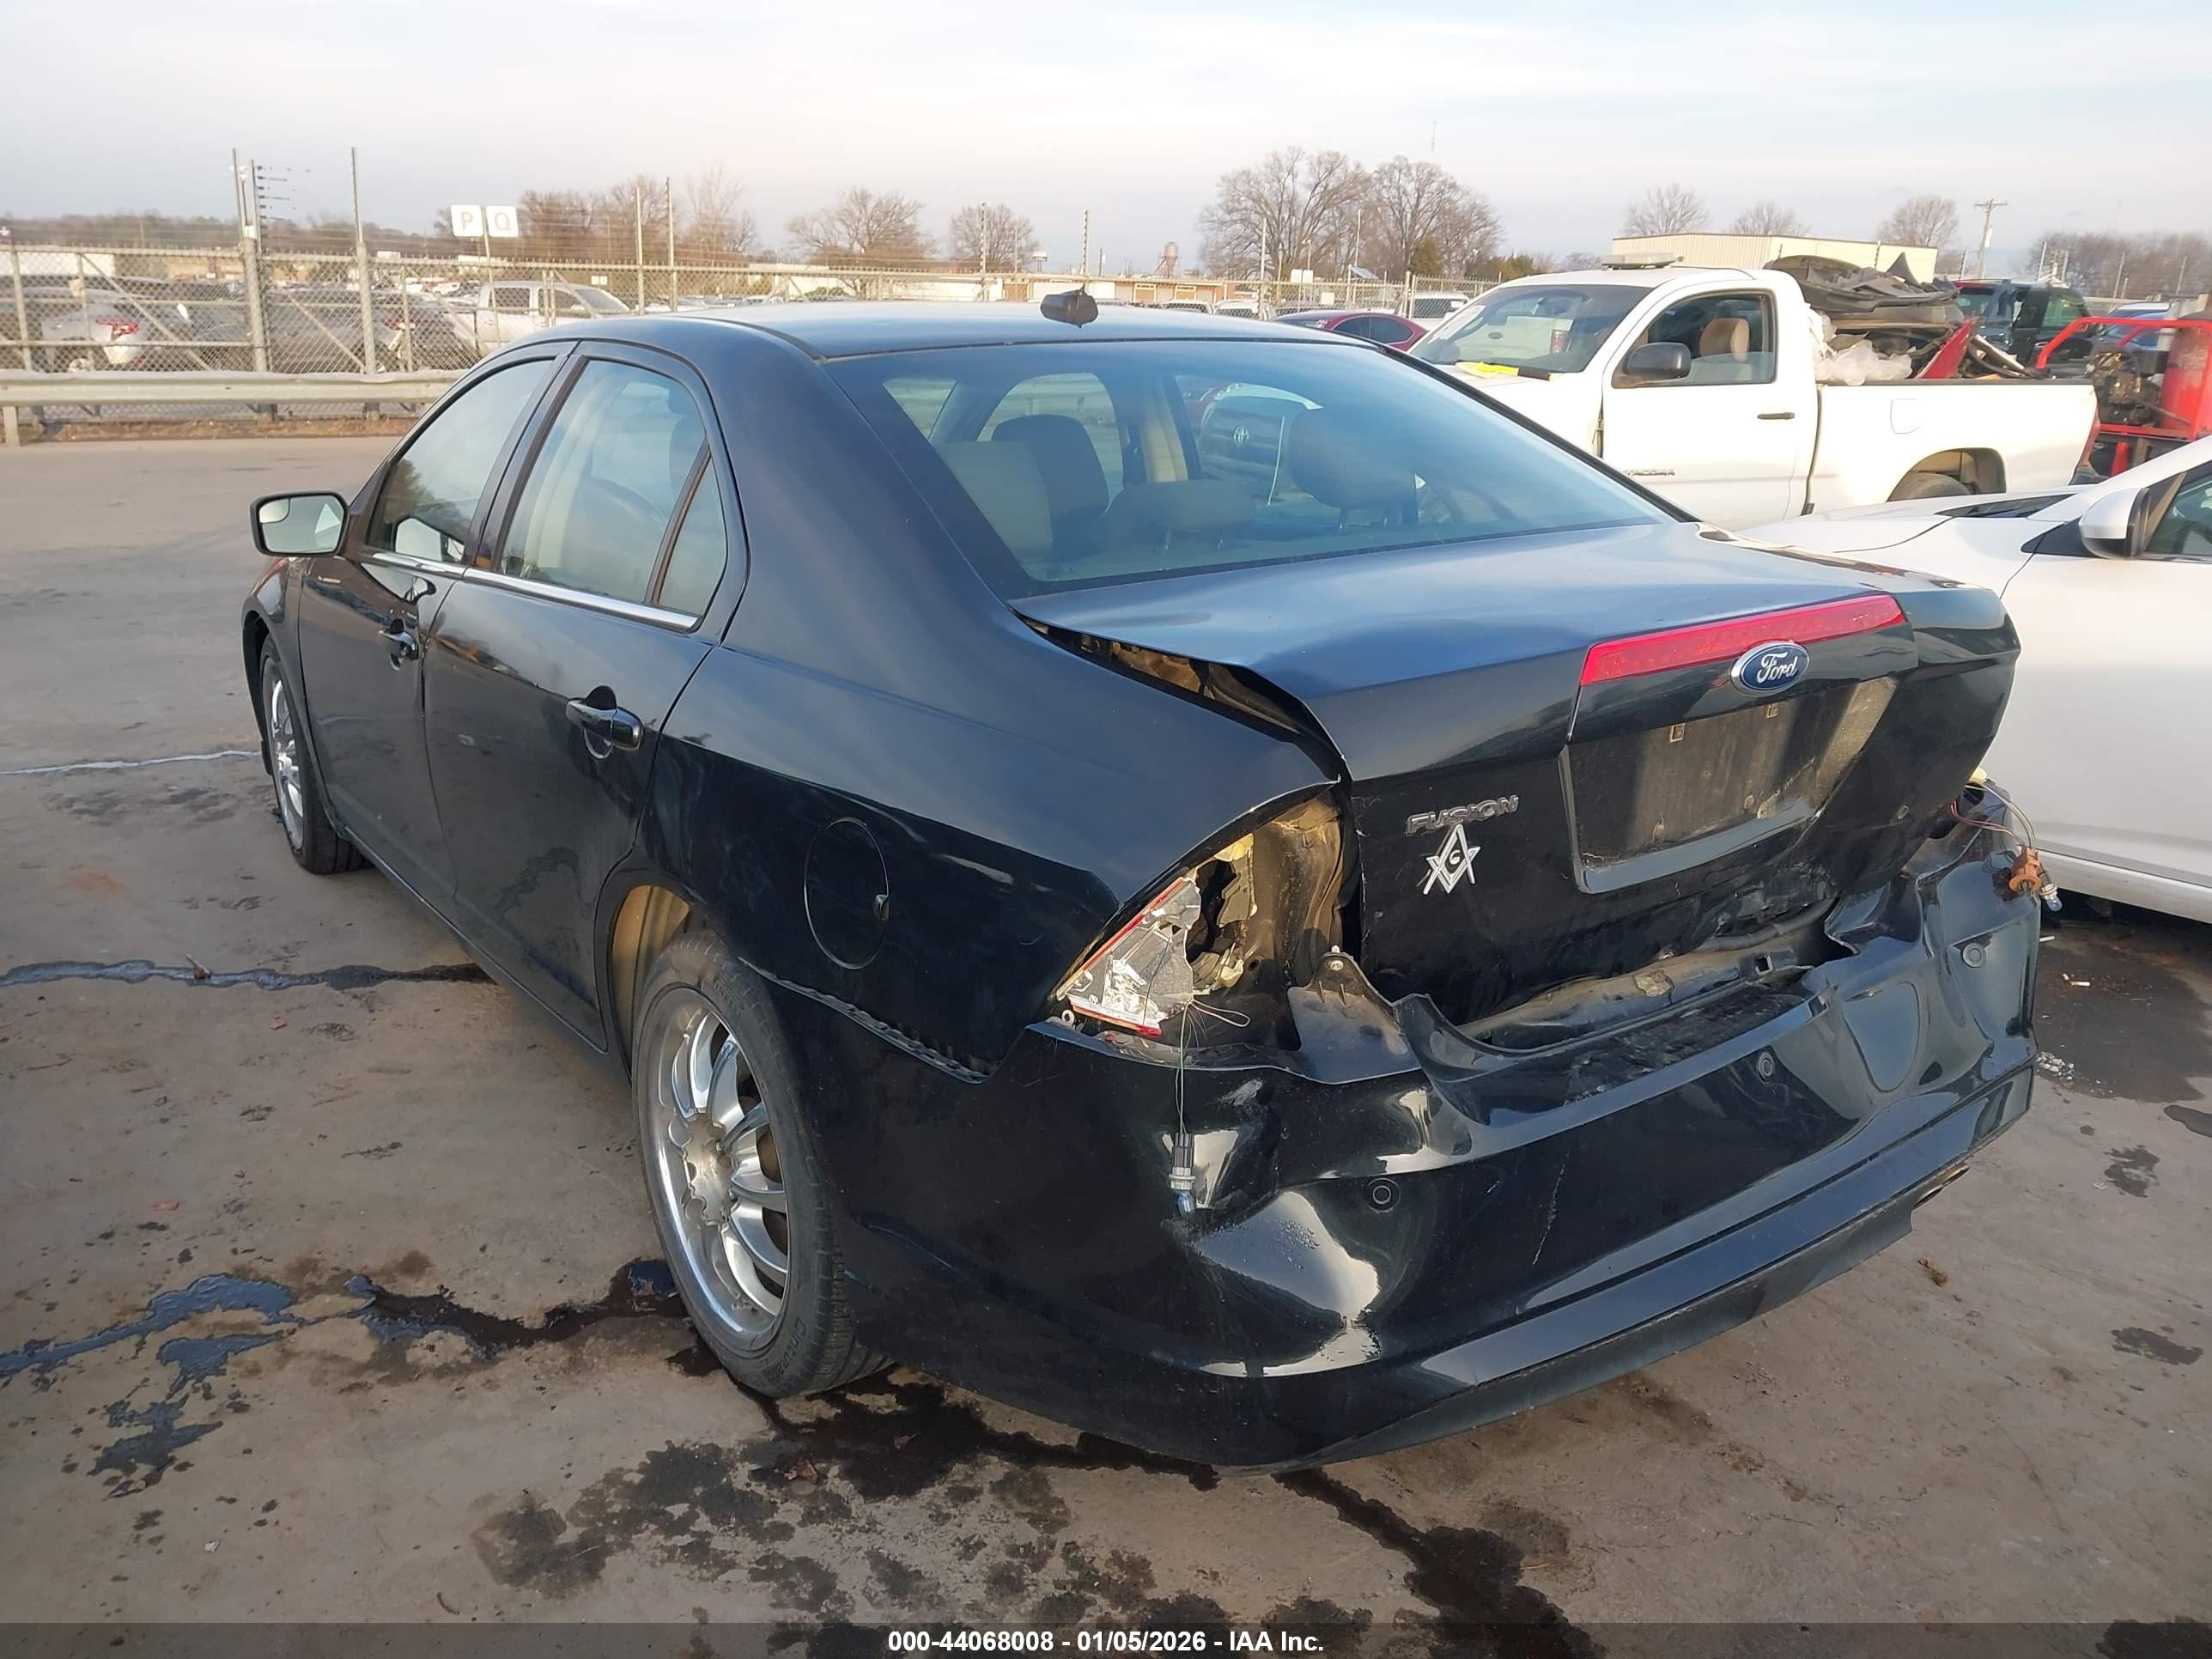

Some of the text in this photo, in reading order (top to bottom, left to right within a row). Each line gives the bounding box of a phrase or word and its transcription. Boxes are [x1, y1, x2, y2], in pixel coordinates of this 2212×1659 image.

[460, 211, 474, 230] P
[494, 212, 512, 231] Q
[1756, 652, 1799, 684] Ford
[1407, 795, 1519, 836] FUSION
